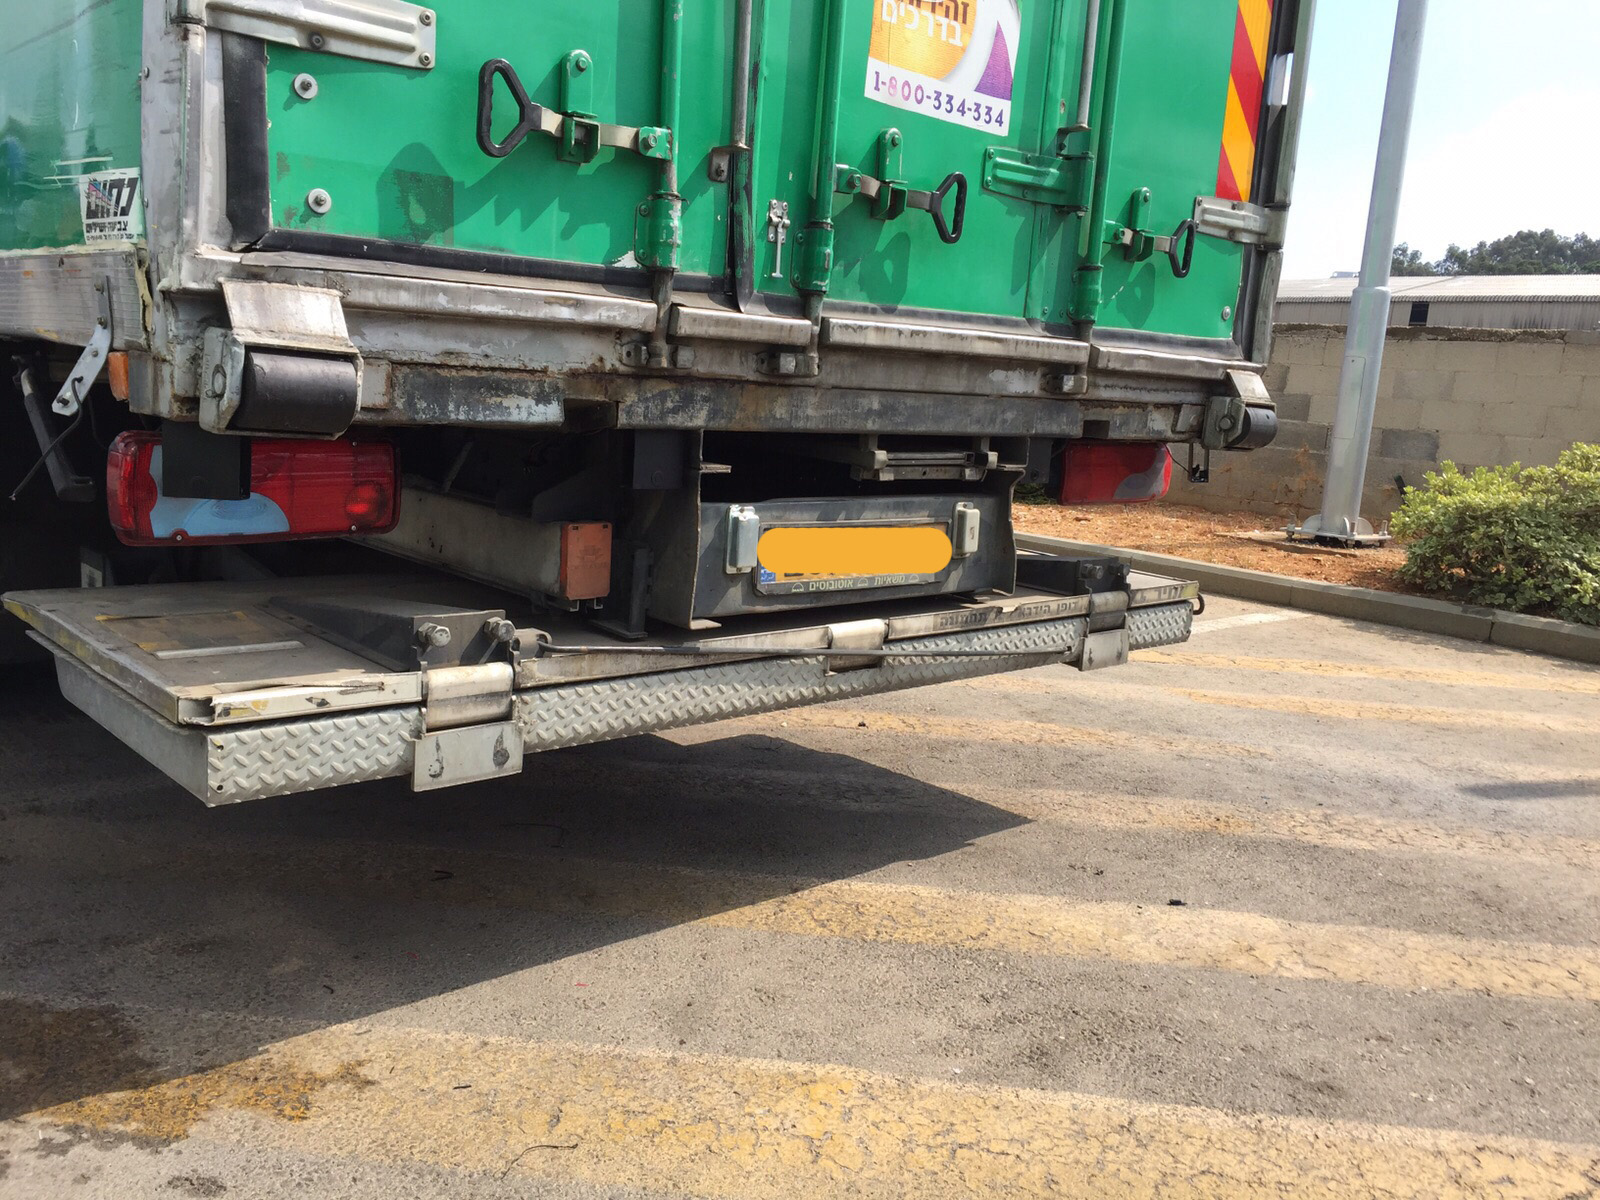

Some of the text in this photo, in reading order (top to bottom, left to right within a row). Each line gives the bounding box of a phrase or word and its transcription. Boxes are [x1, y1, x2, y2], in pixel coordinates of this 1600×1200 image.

[881, 0, 963, 47] בדרכים
[873, 70, 1004, 127] 1-800-334-334
[808, 575, 906, 591] משאיות אוטובוסים
[1056, 600, 1079, 614] דופן
